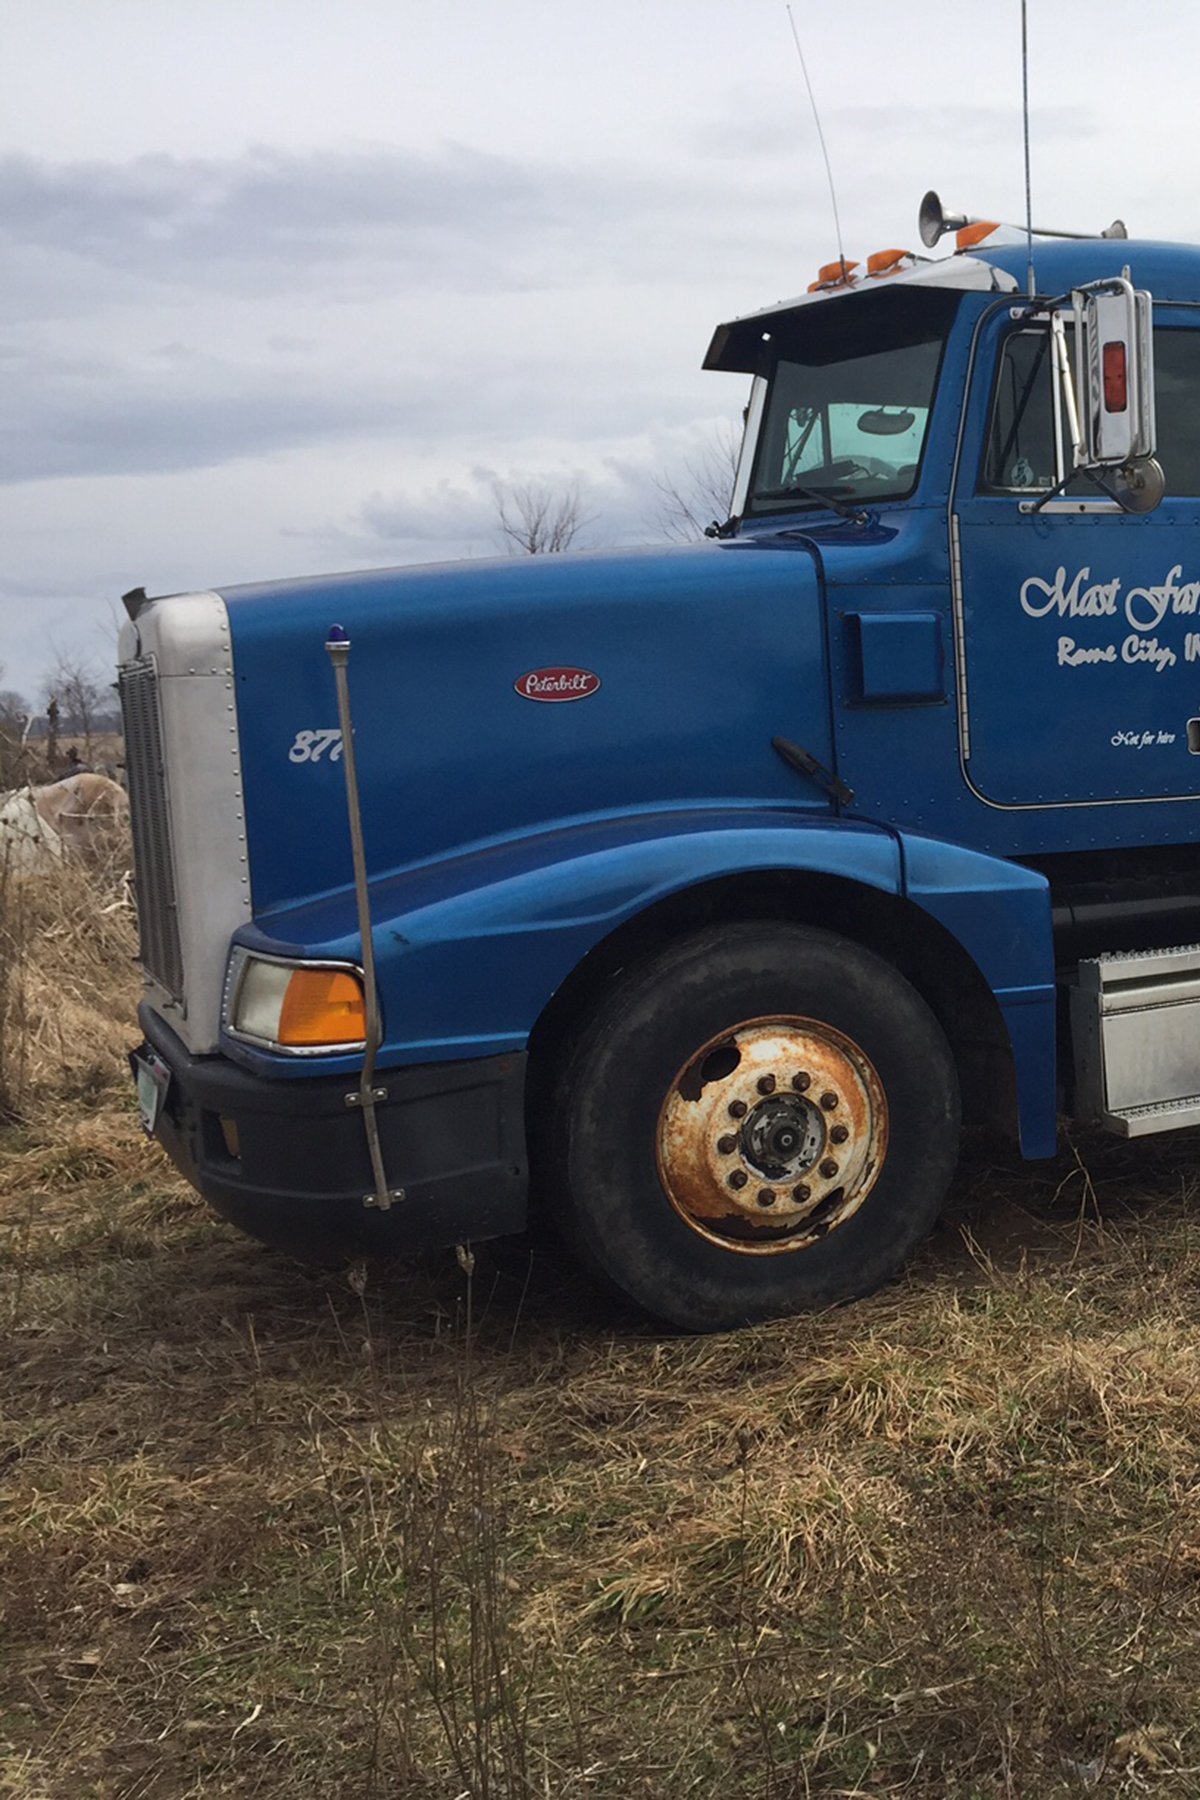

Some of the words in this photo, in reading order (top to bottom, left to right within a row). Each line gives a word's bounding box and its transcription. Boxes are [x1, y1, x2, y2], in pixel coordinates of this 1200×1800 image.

[1020, 566, 1121, 618] Mast
[1057, 636, 1117, 667] Rome
[525, 673, 592, 694] Peterbilt
[1137, 730, 1156, 750] for
